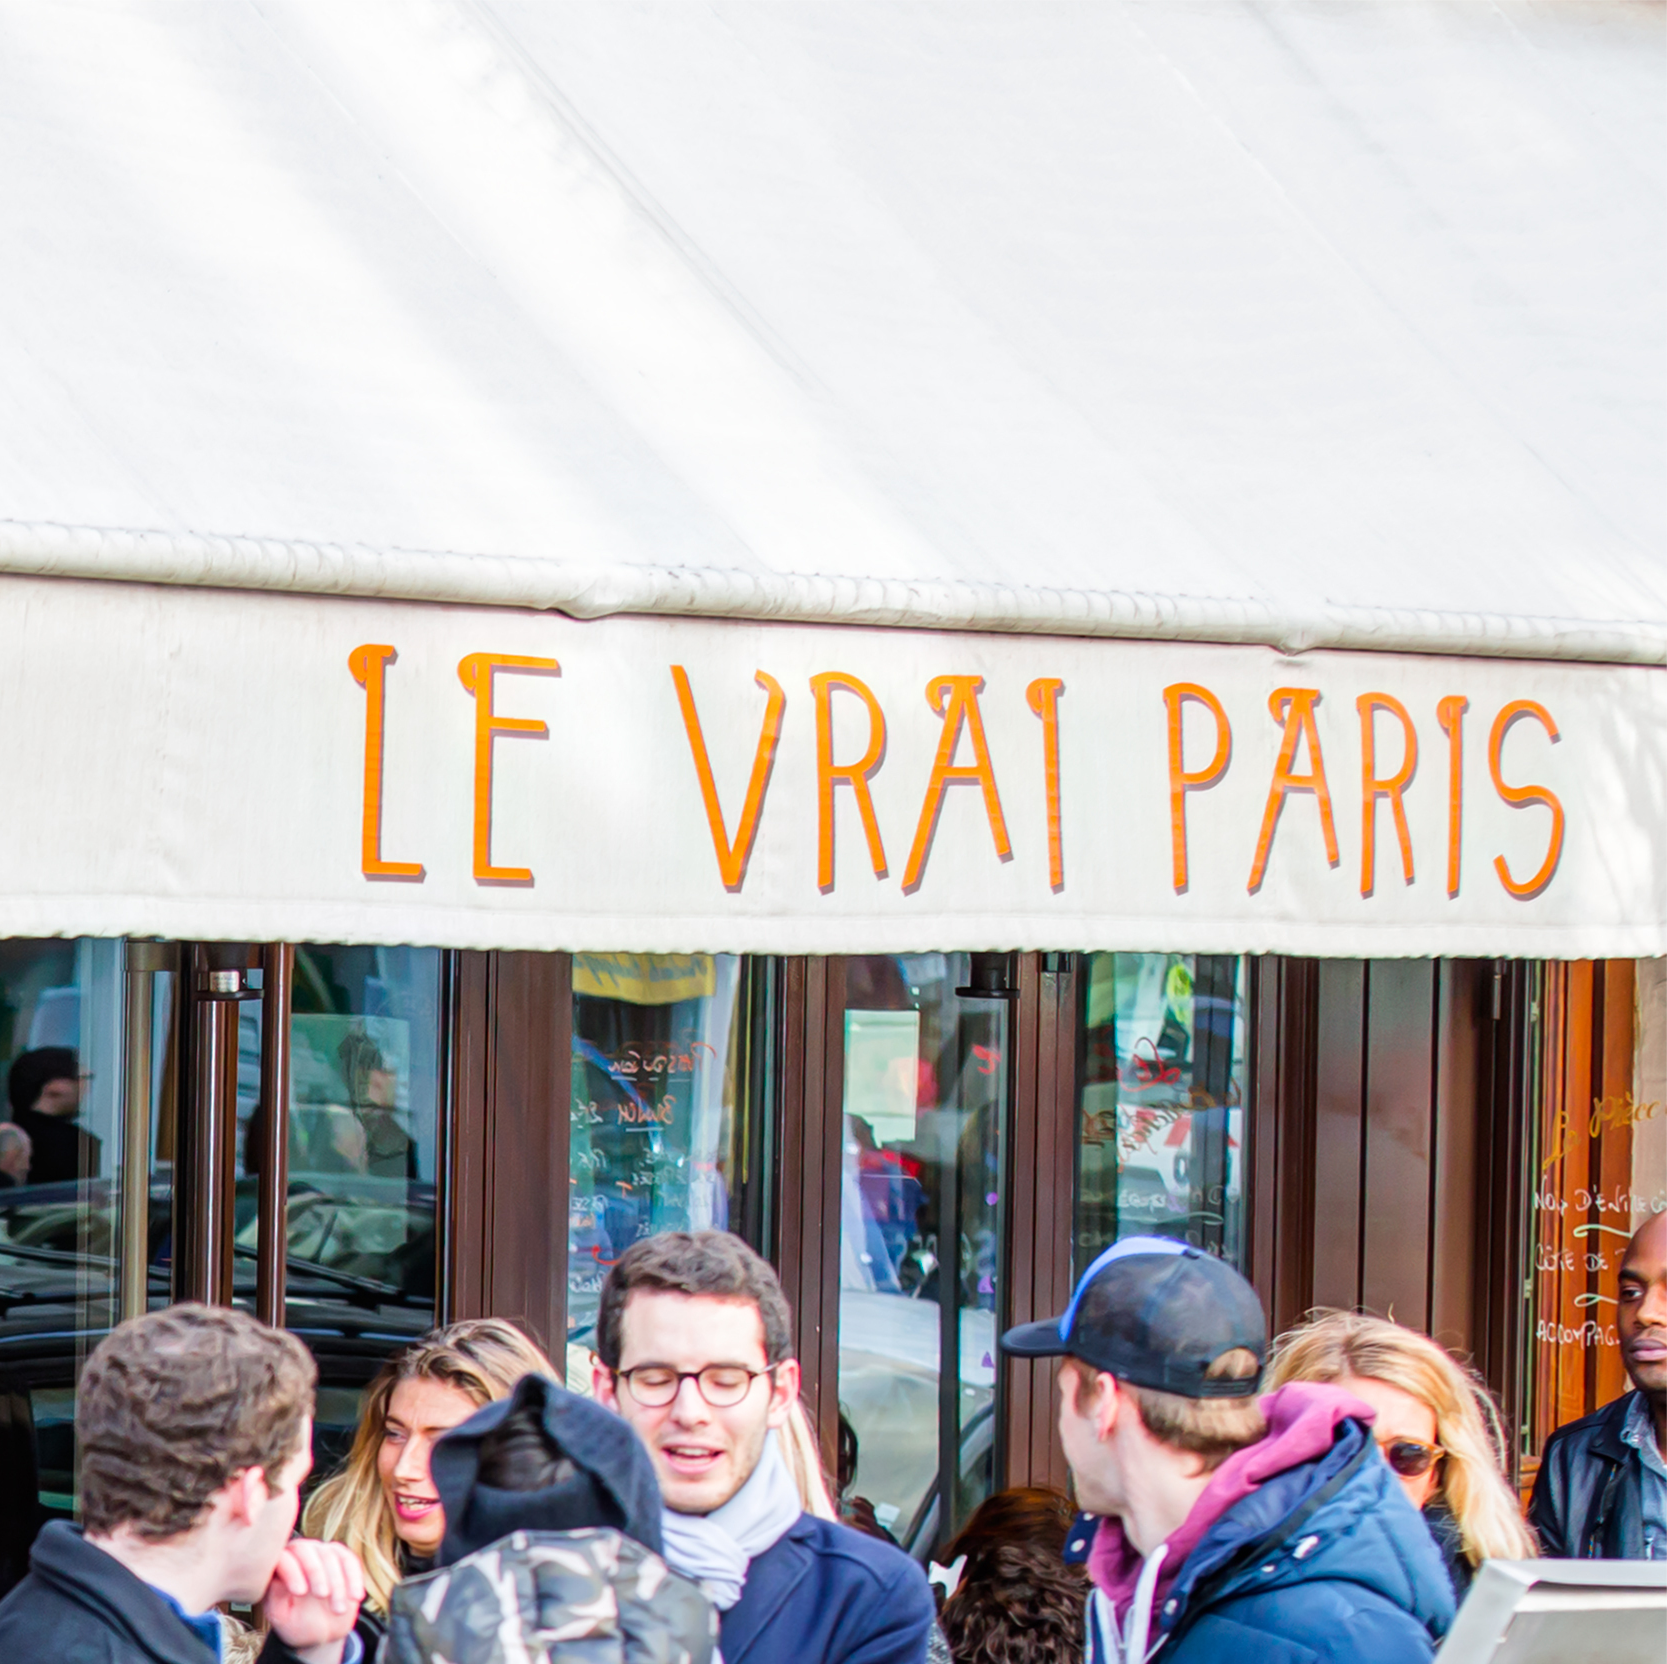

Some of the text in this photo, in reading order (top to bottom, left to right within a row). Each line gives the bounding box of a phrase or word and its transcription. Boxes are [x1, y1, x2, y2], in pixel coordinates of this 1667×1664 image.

[348, 642, 1567, 900] LE VRAI PARIS
